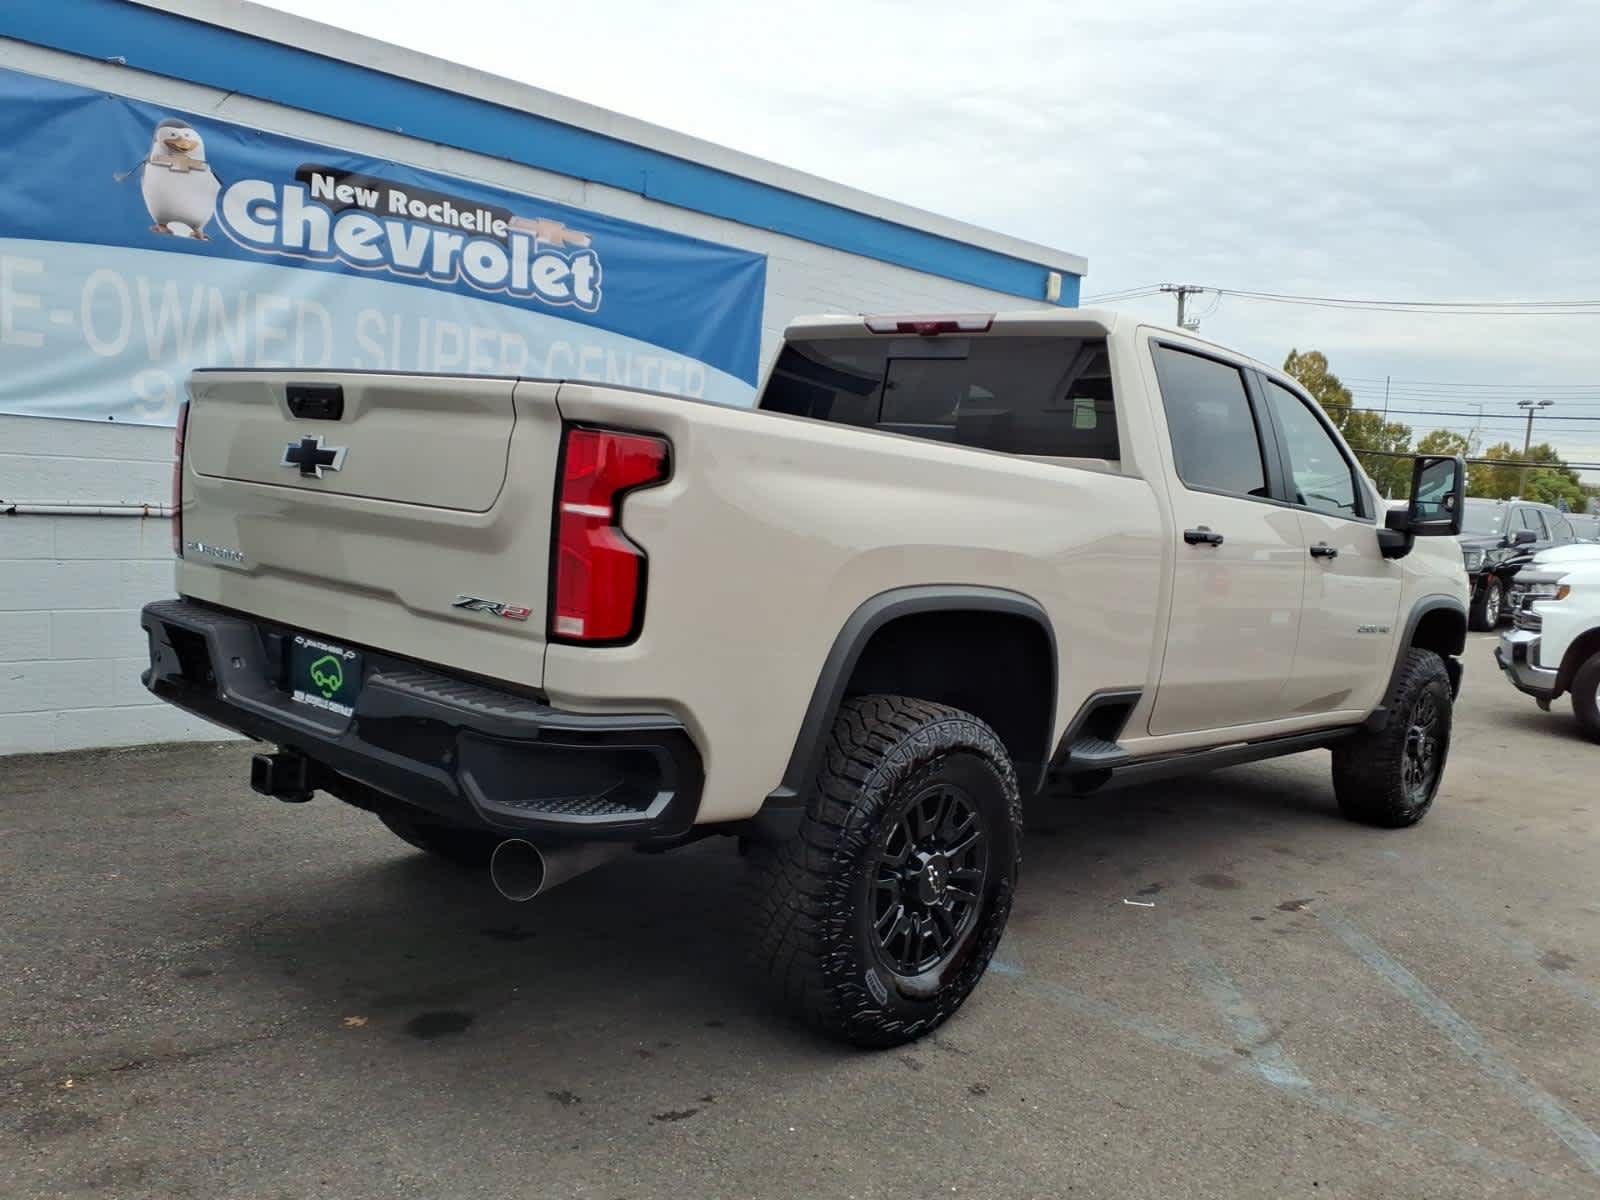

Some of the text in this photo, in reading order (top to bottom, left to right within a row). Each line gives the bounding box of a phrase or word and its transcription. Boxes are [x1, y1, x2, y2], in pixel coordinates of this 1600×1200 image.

[310, 172, 508, 239] New Rochelle
[221, 178, 597, 305] Chevrolet
[452, 594, 533, 621] ZR2
